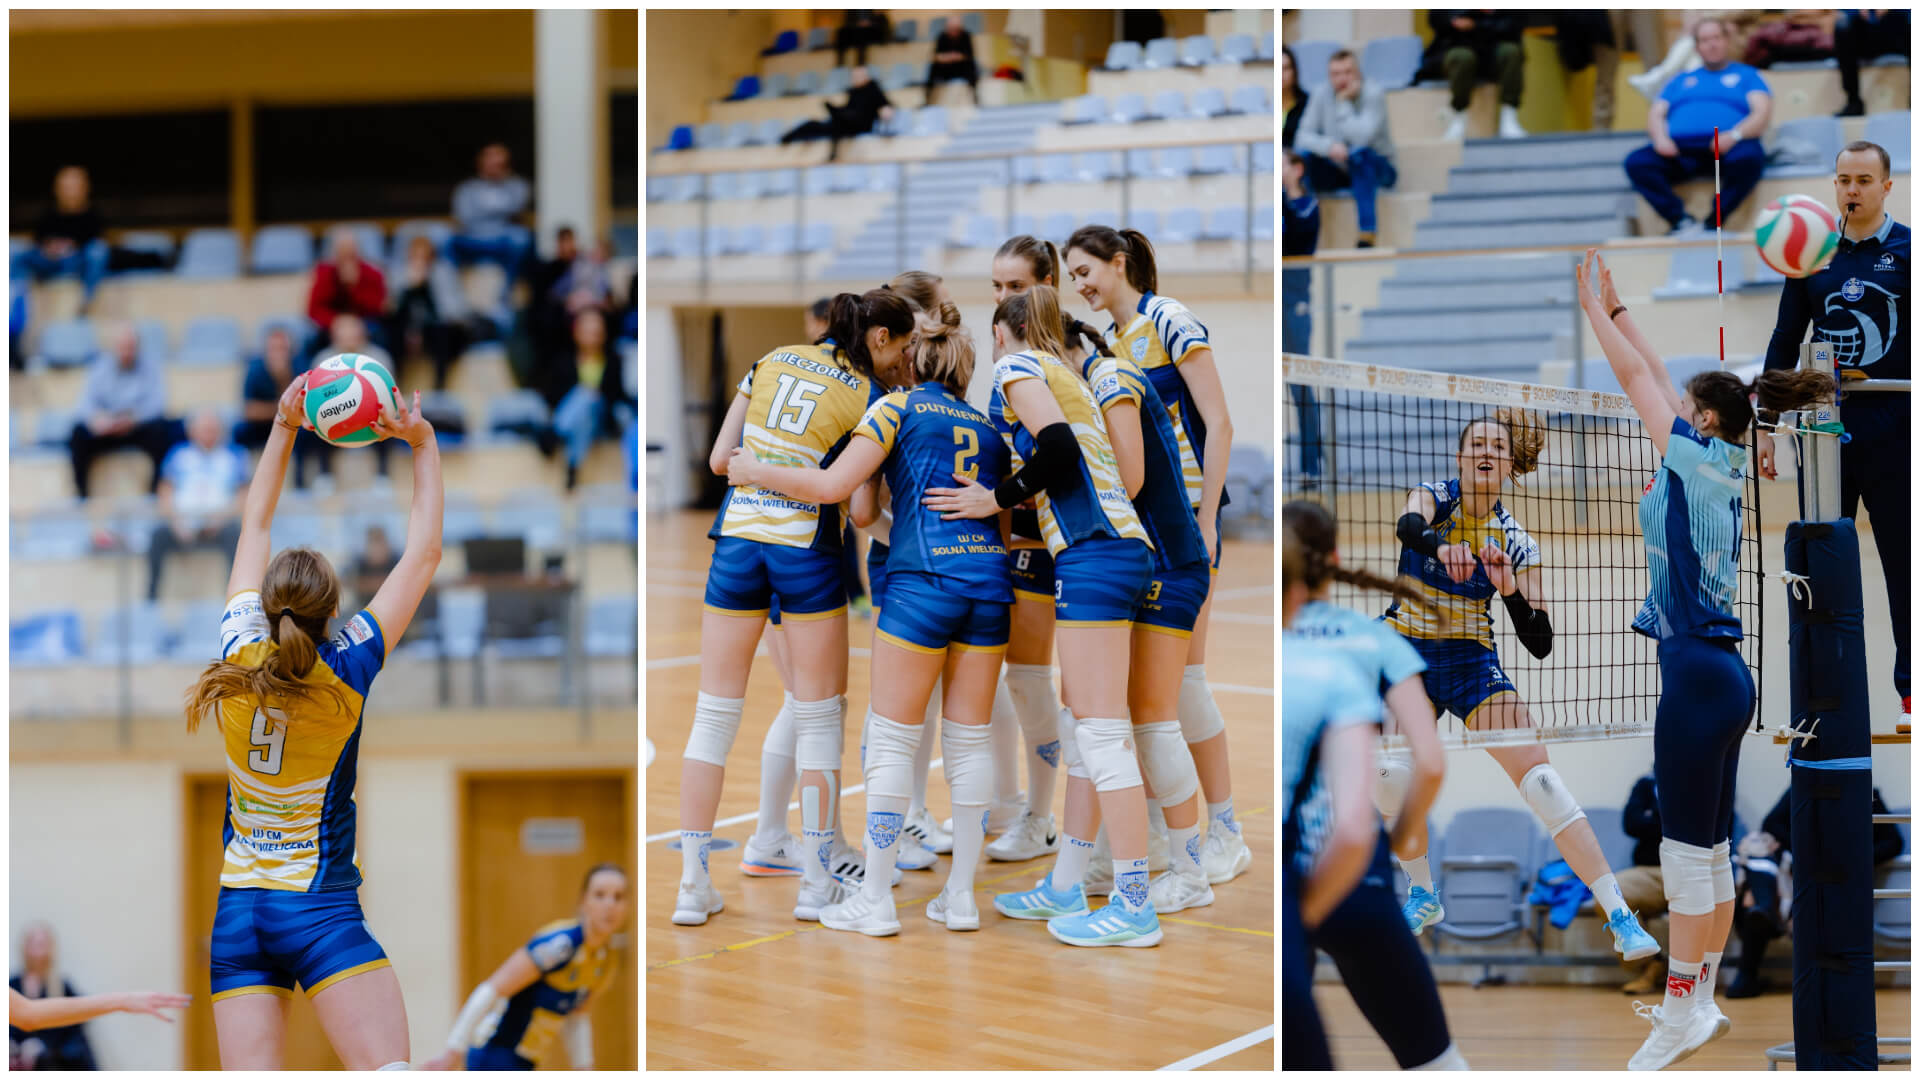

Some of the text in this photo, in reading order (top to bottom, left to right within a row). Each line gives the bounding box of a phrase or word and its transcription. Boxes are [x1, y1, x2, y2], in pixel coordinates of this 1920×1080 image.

[771, 352, 862, 391] WIECZOREK
[320, 398, 357, 419] molten
[765, 372, 828, 436] 15
[953, 425, 979, 481] 2
[763, 498, 818, 514] WIELICZKA
[931, 545, 967, 557] SOLNA
[1016, 550, 1032, 571] 6
[1489, 665, 1503, 679] 3
[248, 706, 288, 776] 9
[252, 828, 281, 841] UJ CM
[259, 839, 315, 852] WIELICZKA
